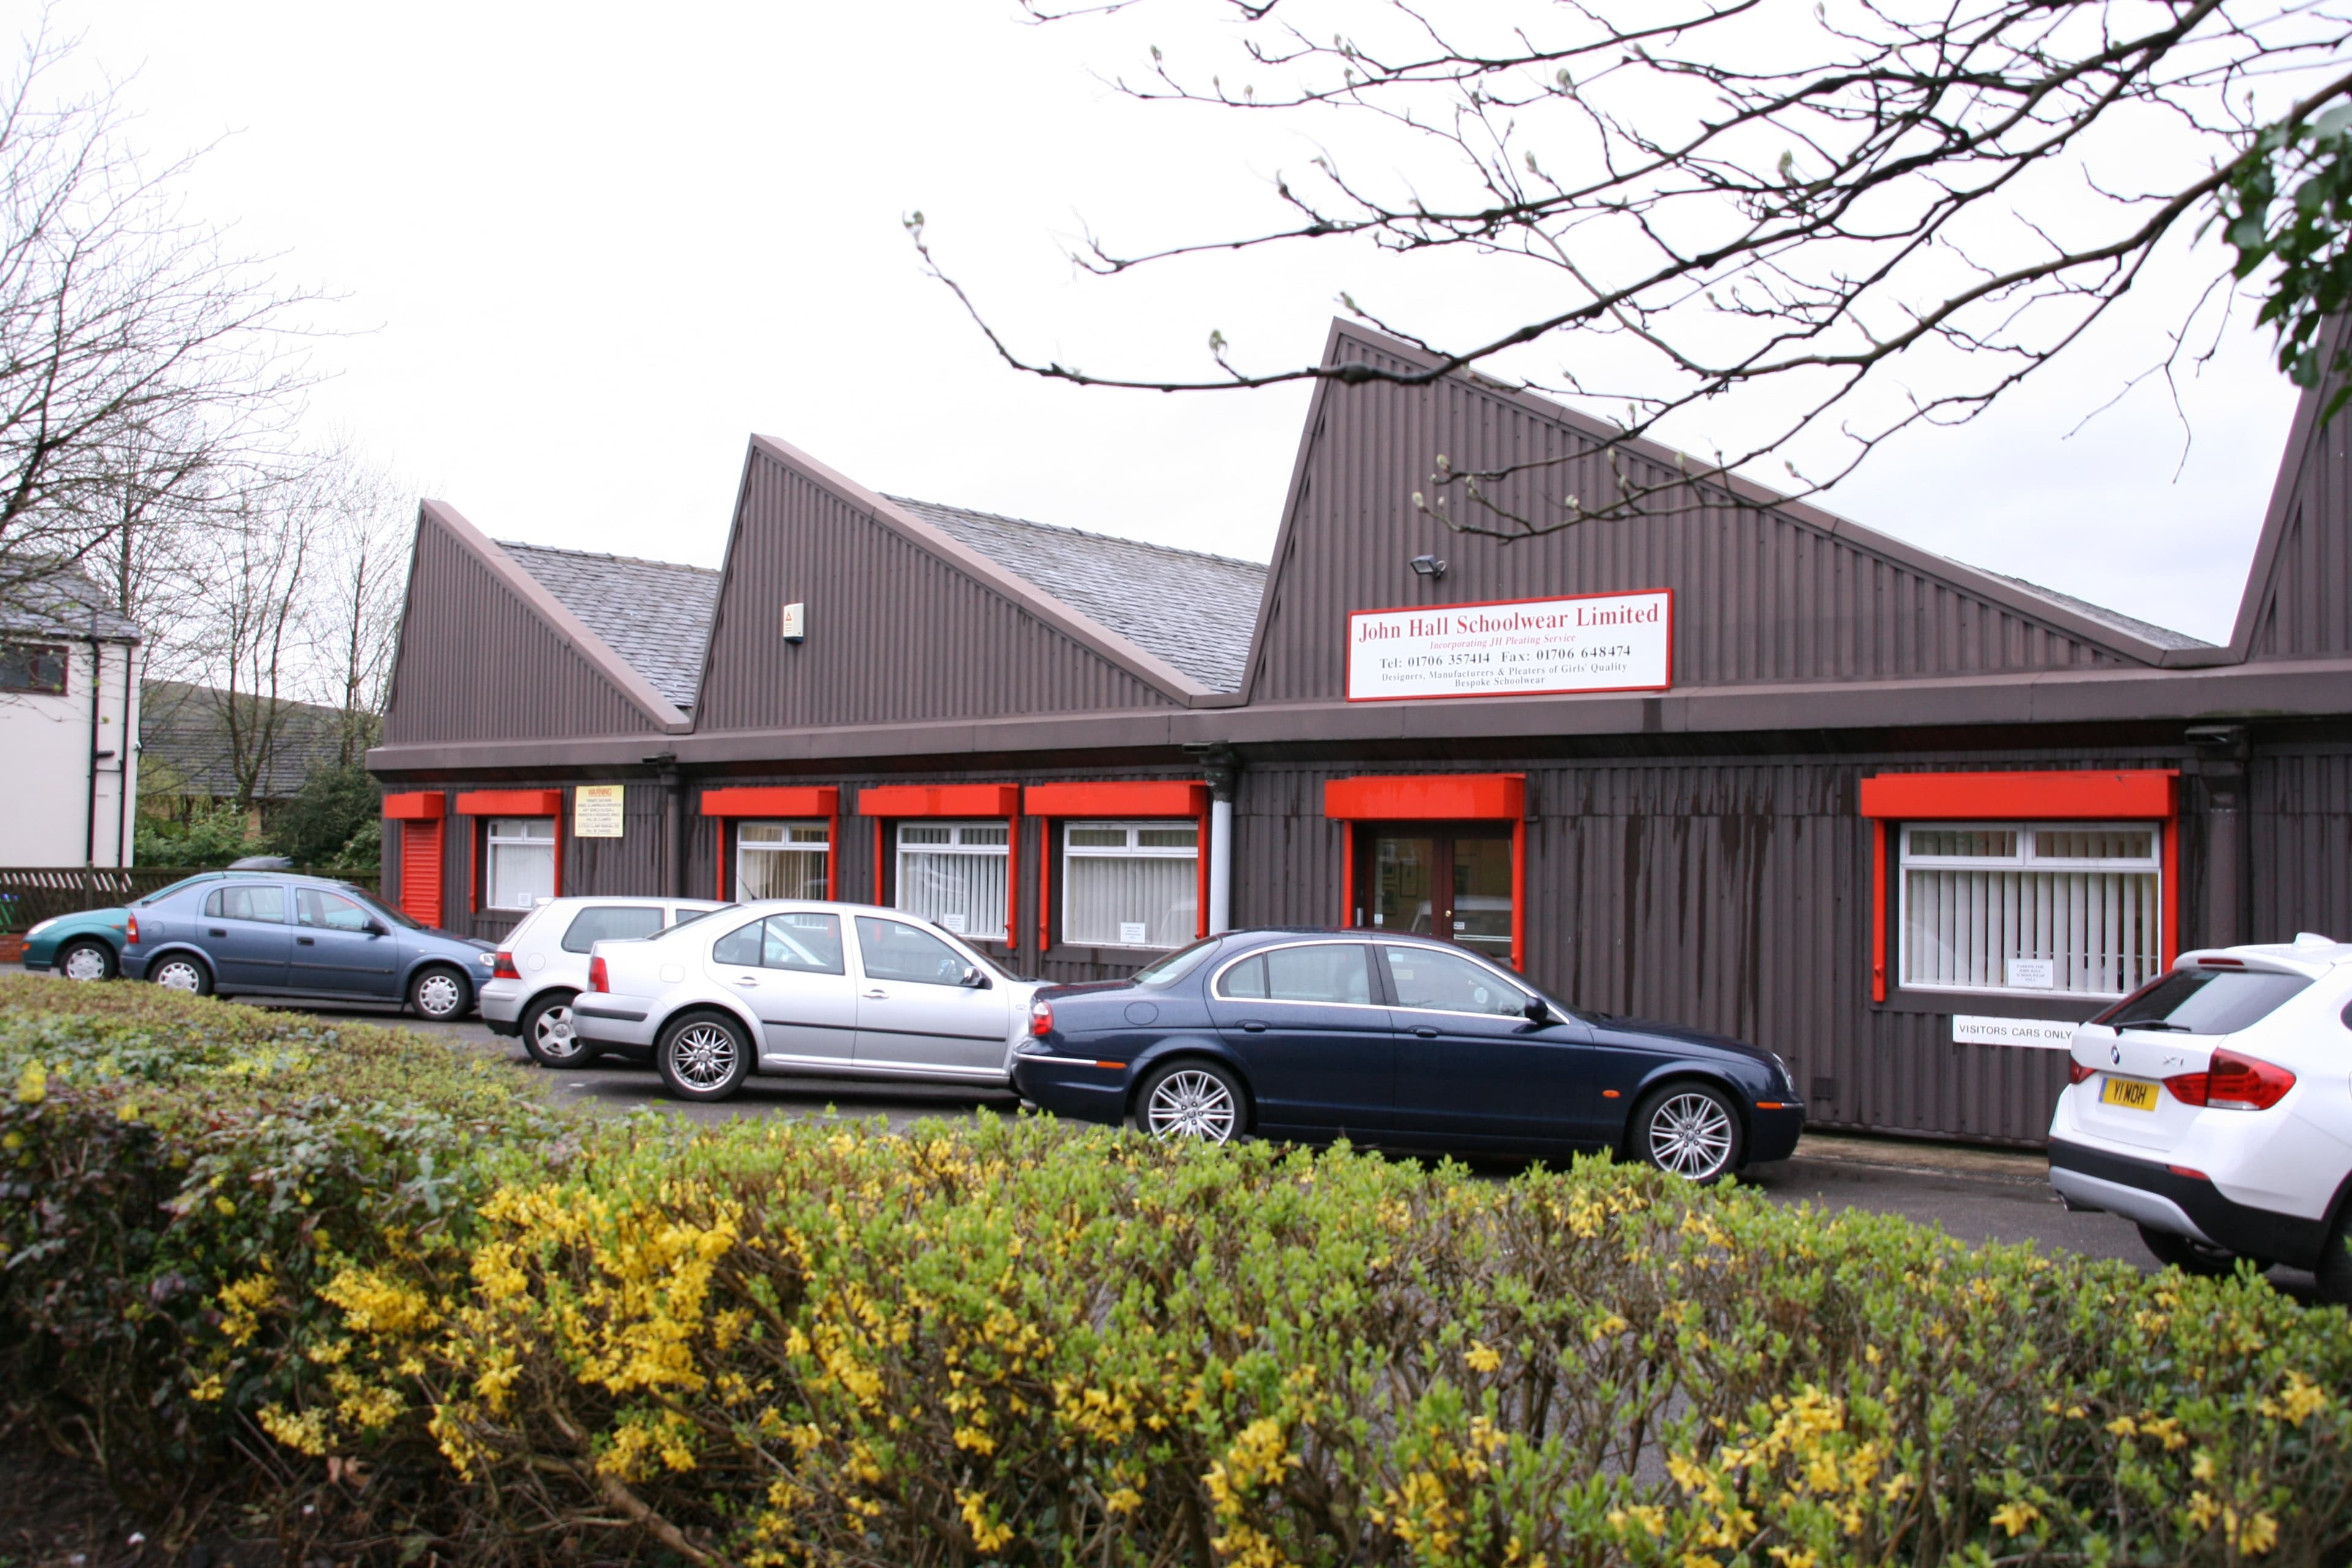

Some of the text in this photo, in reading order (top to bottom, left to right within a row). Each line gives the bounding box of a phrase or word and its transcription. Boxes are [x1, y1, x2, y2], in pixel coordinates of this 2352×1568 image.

[1359, 603, 1659, 643] John Hall Schoolwear Limited
[1430, 633, 1577, 650] Incorporating JH Pleating Service
[1379, 645, 1631, 669] Tel: 01706 357414 Fax: 01706 648474
[1382, 662, 1627, 682] Designers, Manufacturers & Pleaters of Girls' Quality
[1455, 677, 1546, 688] Bespoke Schoolwear
[1959, 1023, 2073, 1039] VISITORS CARS ONLY
